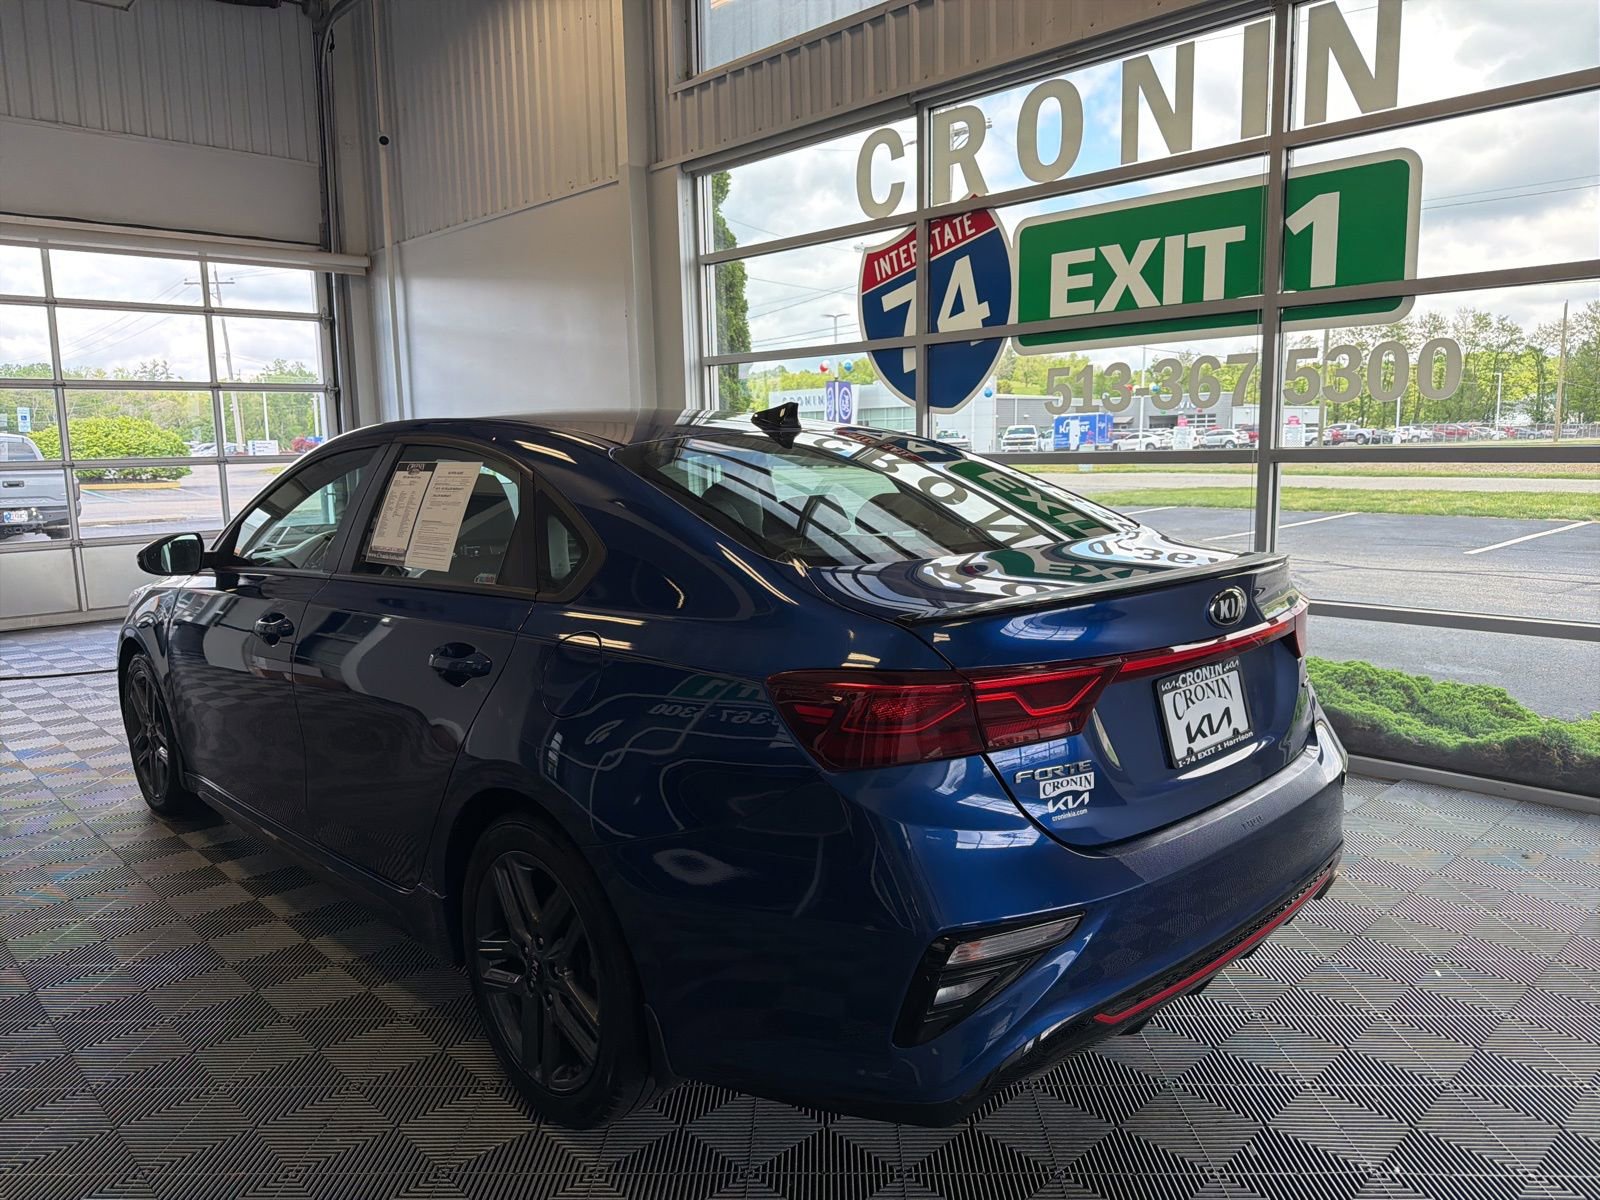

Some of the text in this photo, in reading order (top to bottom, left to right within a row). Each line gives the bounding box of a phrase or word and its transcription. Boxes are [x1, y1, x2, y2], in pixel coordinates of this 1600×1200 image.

[856, 0, 1403, 219] CRONIN
[1050, 191, 1340, 318] EXIT 1
[881, 254, 991, 374] 74
[1044, 337, 1463, 416] 513-3675300
[1220, 598, 1241, 619] KIA
[1178, 663, 1224, 688] CRONIN
[1173, 675, 1234, 721] CRONIN
[1185, 706, 1232, 744] KIA
[1178, 755, 1196, 768] I-74
[1197, 746, 1216, 760] EXIT
[1223, 731, 1254, 748] Harrison
[1015, 760, 1092, 784] FORTE
[1042, 774, 1092, 796] CRONIN
[1048, 792, 1089, 813] KIA
[1052, 808, 1088, 822] croninkia.com
